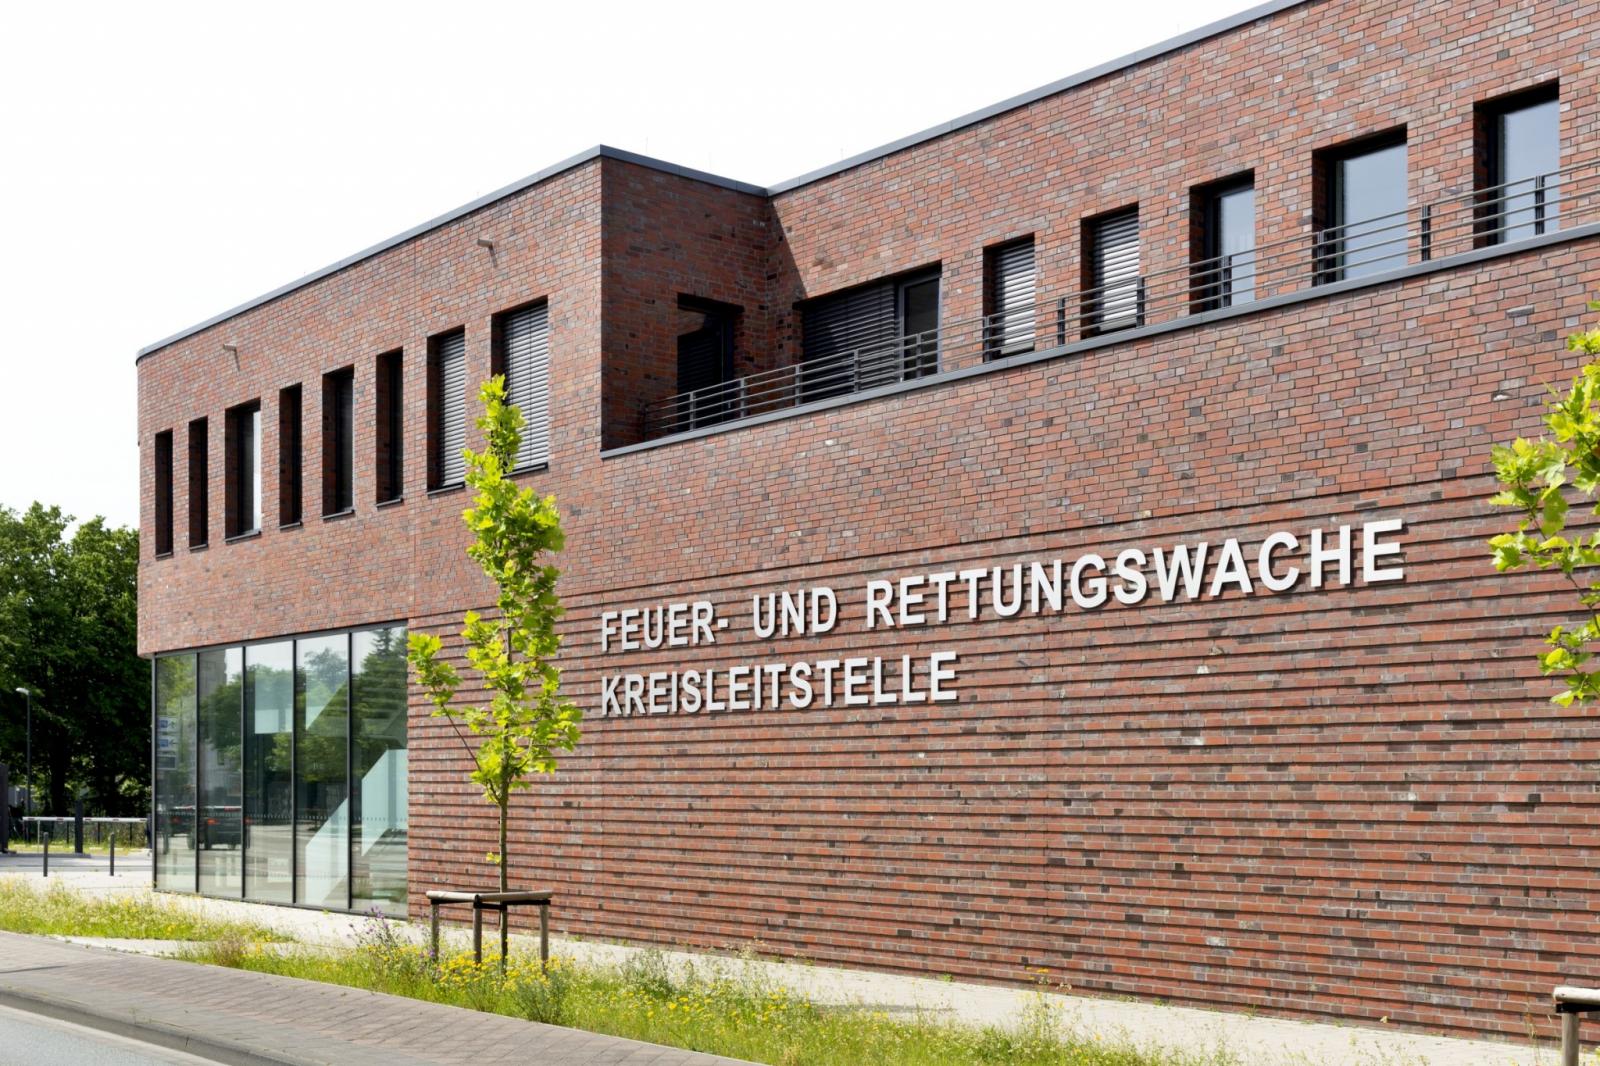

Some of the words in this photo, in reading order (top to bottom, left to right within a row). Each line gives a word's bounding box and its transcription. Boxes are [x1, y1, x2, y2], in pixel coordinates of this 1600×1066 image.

[600, 600, 729, 652] FEUER-
[752, 586, 837, 638] UND
[866, 518, 1404, 628] RETTUNGSWACHE
[601, 650, 958, 717] KREISLEITSTELLE
